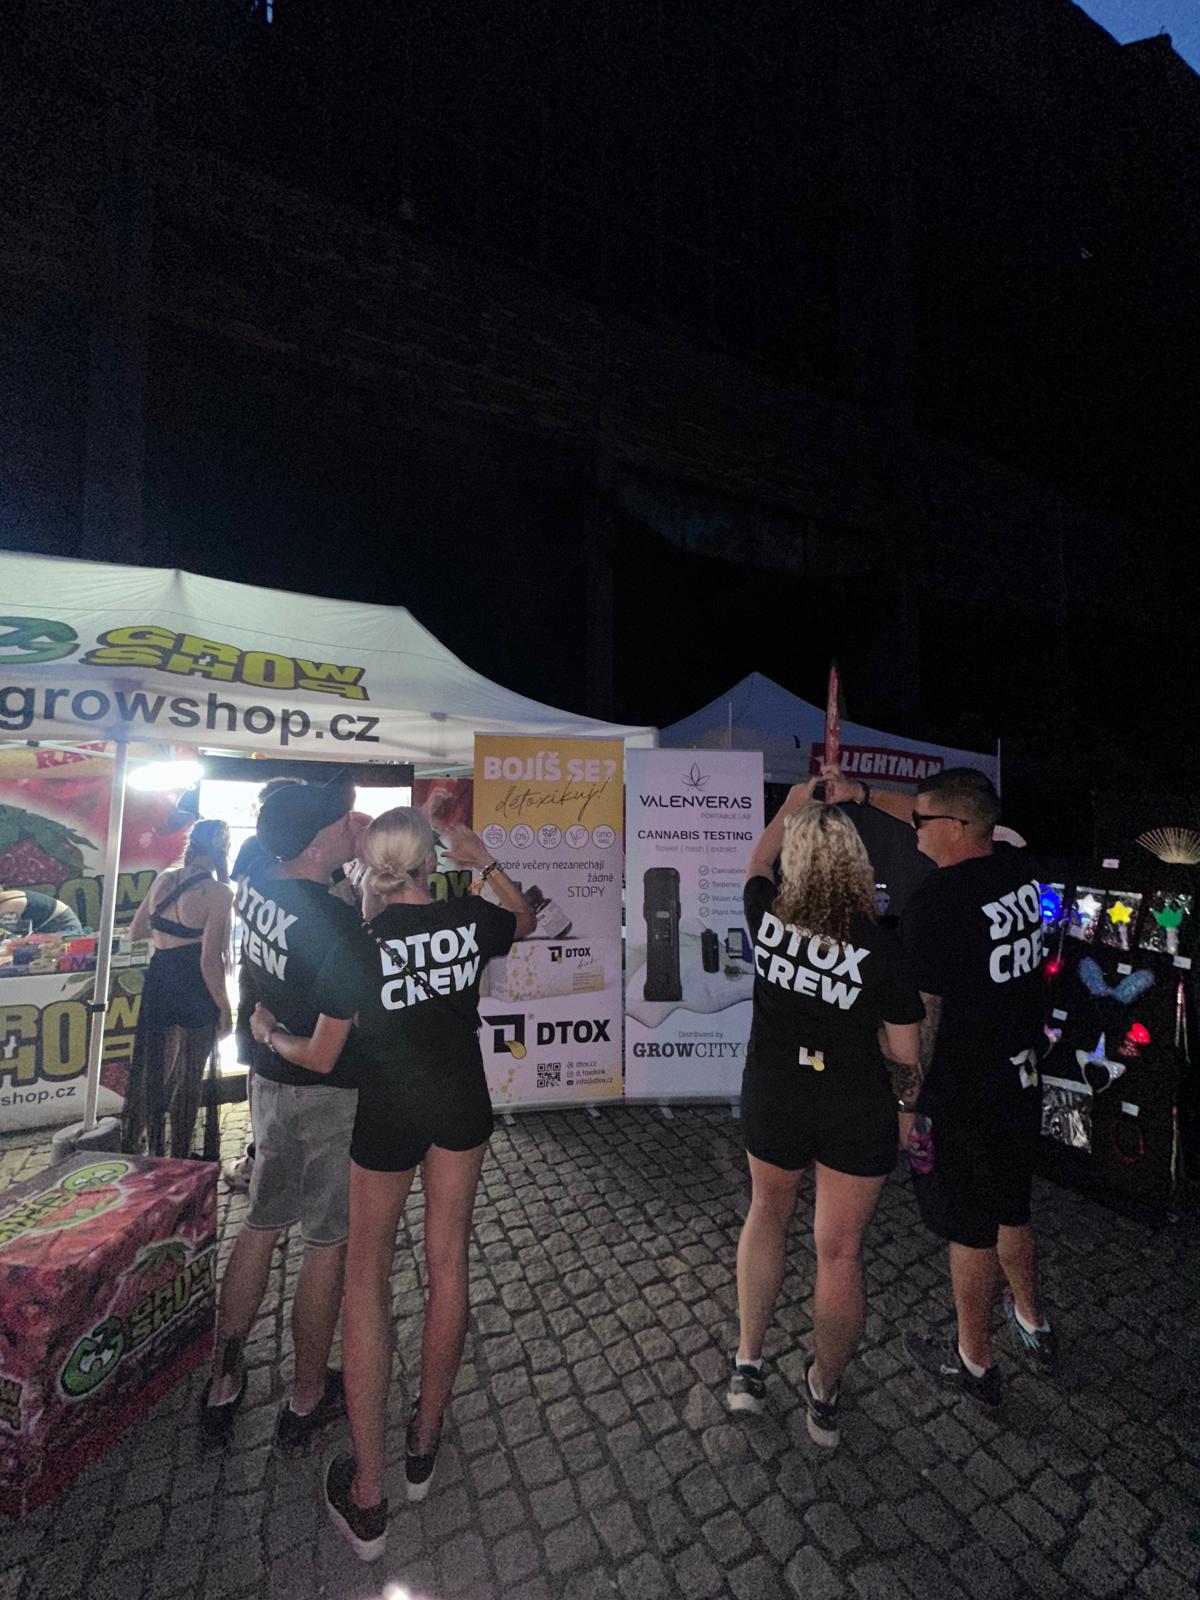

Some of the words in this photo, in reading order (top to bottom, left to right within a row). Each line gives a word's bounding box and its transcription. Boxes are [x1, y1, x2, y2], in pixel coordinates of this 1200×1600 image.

[483, 751, 562, 781] BOJÍŠ
[566, 758, 618, 782] SE?
[841, 751, 941, 779] LIGHTMAN
[495, 775, 613, 822] detoxikuj!
[639, 795, 752, 809] VALENVERAS
[637, 830, 700, 840] CANNABIS
[702, 831, 753, 841] TESTING
[522, 860, 551, 871] večery
[552, 860, 605, 871] nezanechají
[587, 872, 614, 883] žádné
[567, 886, 606, 898] STOPY
[981, 879, 1042, 940] DTO
[381, 922, 480, 976] DTOX
[565, 947, 591, 958] DTOX
[757, 912, 871, 984] DTOX
[989, 928, 1050, 983] CRE
[380, 955, 481, 1011] CREW
[754, 945, 862, 1010] CREW
[536, 1019, 611, 1045] DTOX
[632, 1042, 742, 1058] GROWCITY
